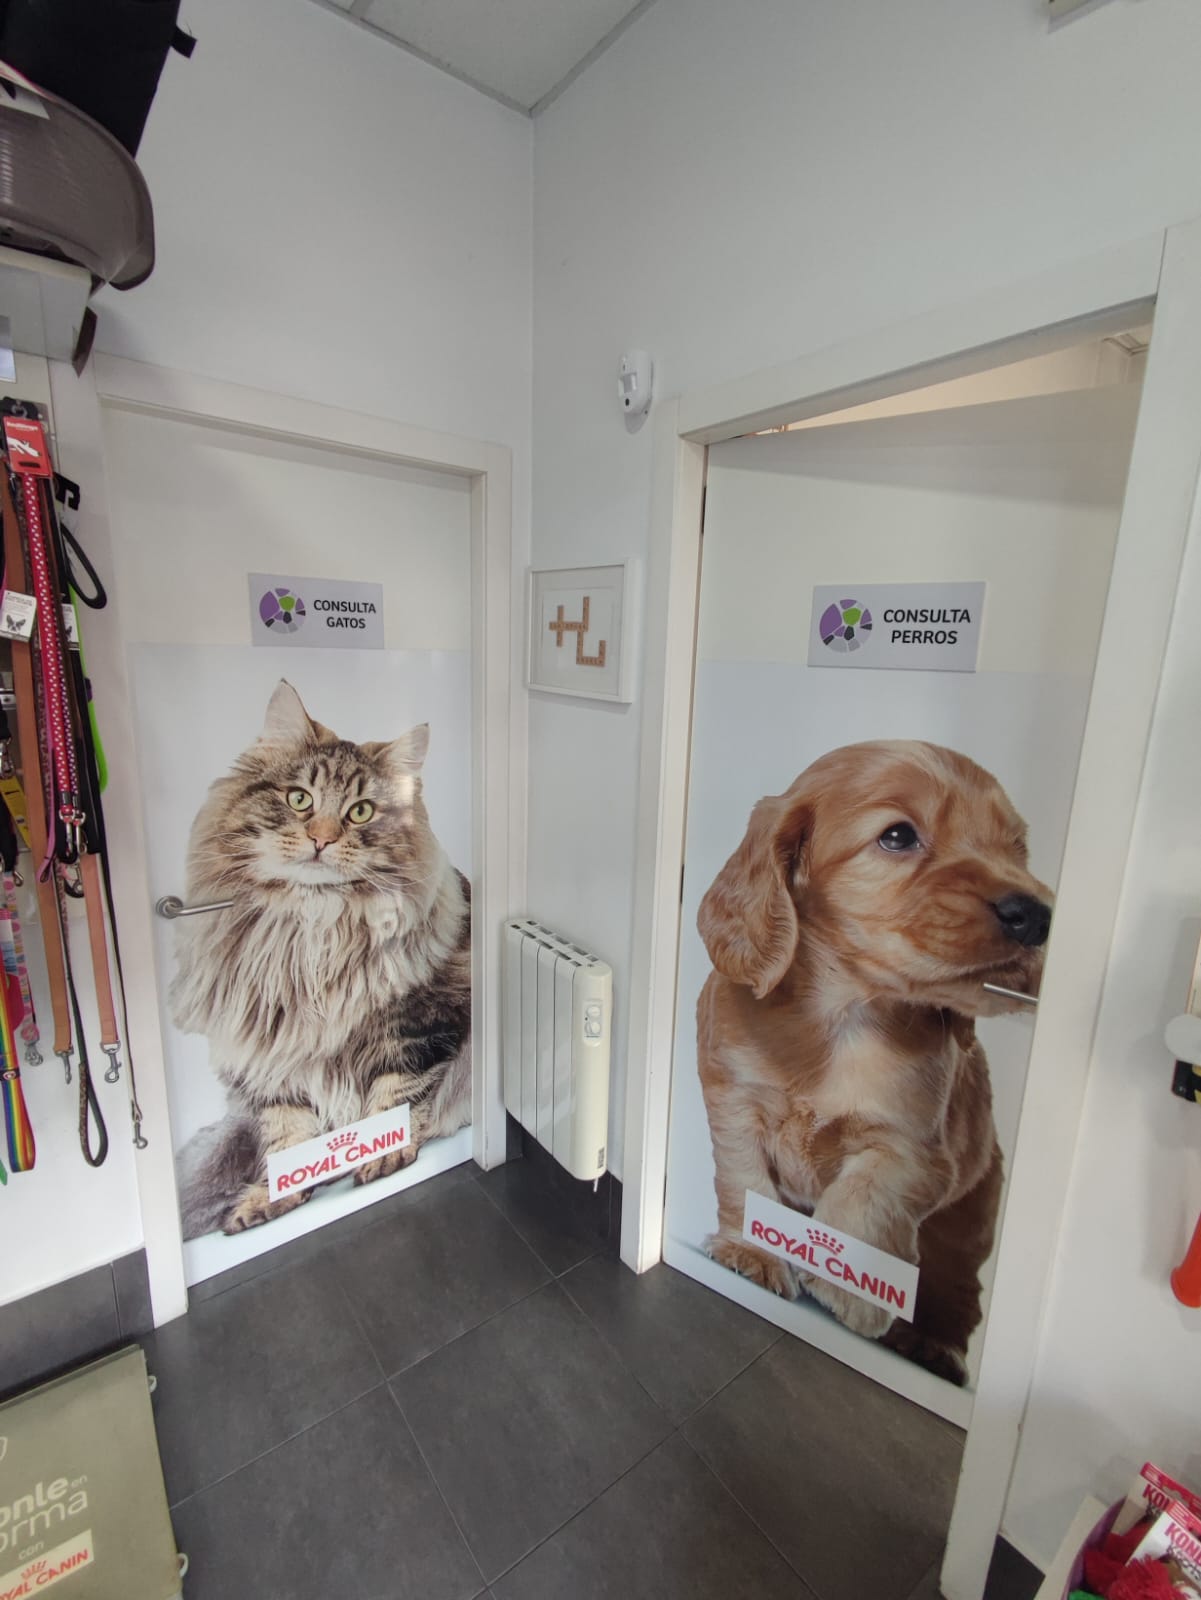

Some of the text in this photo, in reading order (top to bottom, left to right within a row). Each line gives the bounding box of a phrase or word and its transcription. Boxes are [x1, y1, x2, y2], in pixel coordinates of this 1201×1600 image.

[313, 599, 376, 614] CONSULTA
[326, 616, 366, 629] GATOS
[883, 609, 971, 624] CONSULTA
[891, 630, 958, 645] PERROS
[277, 1127, 404, 1192] ROYAL CANIN
[751, 1220, 906, 1309] ROYAL CANIN
[36, 1548, 88, 1585] CANIN
